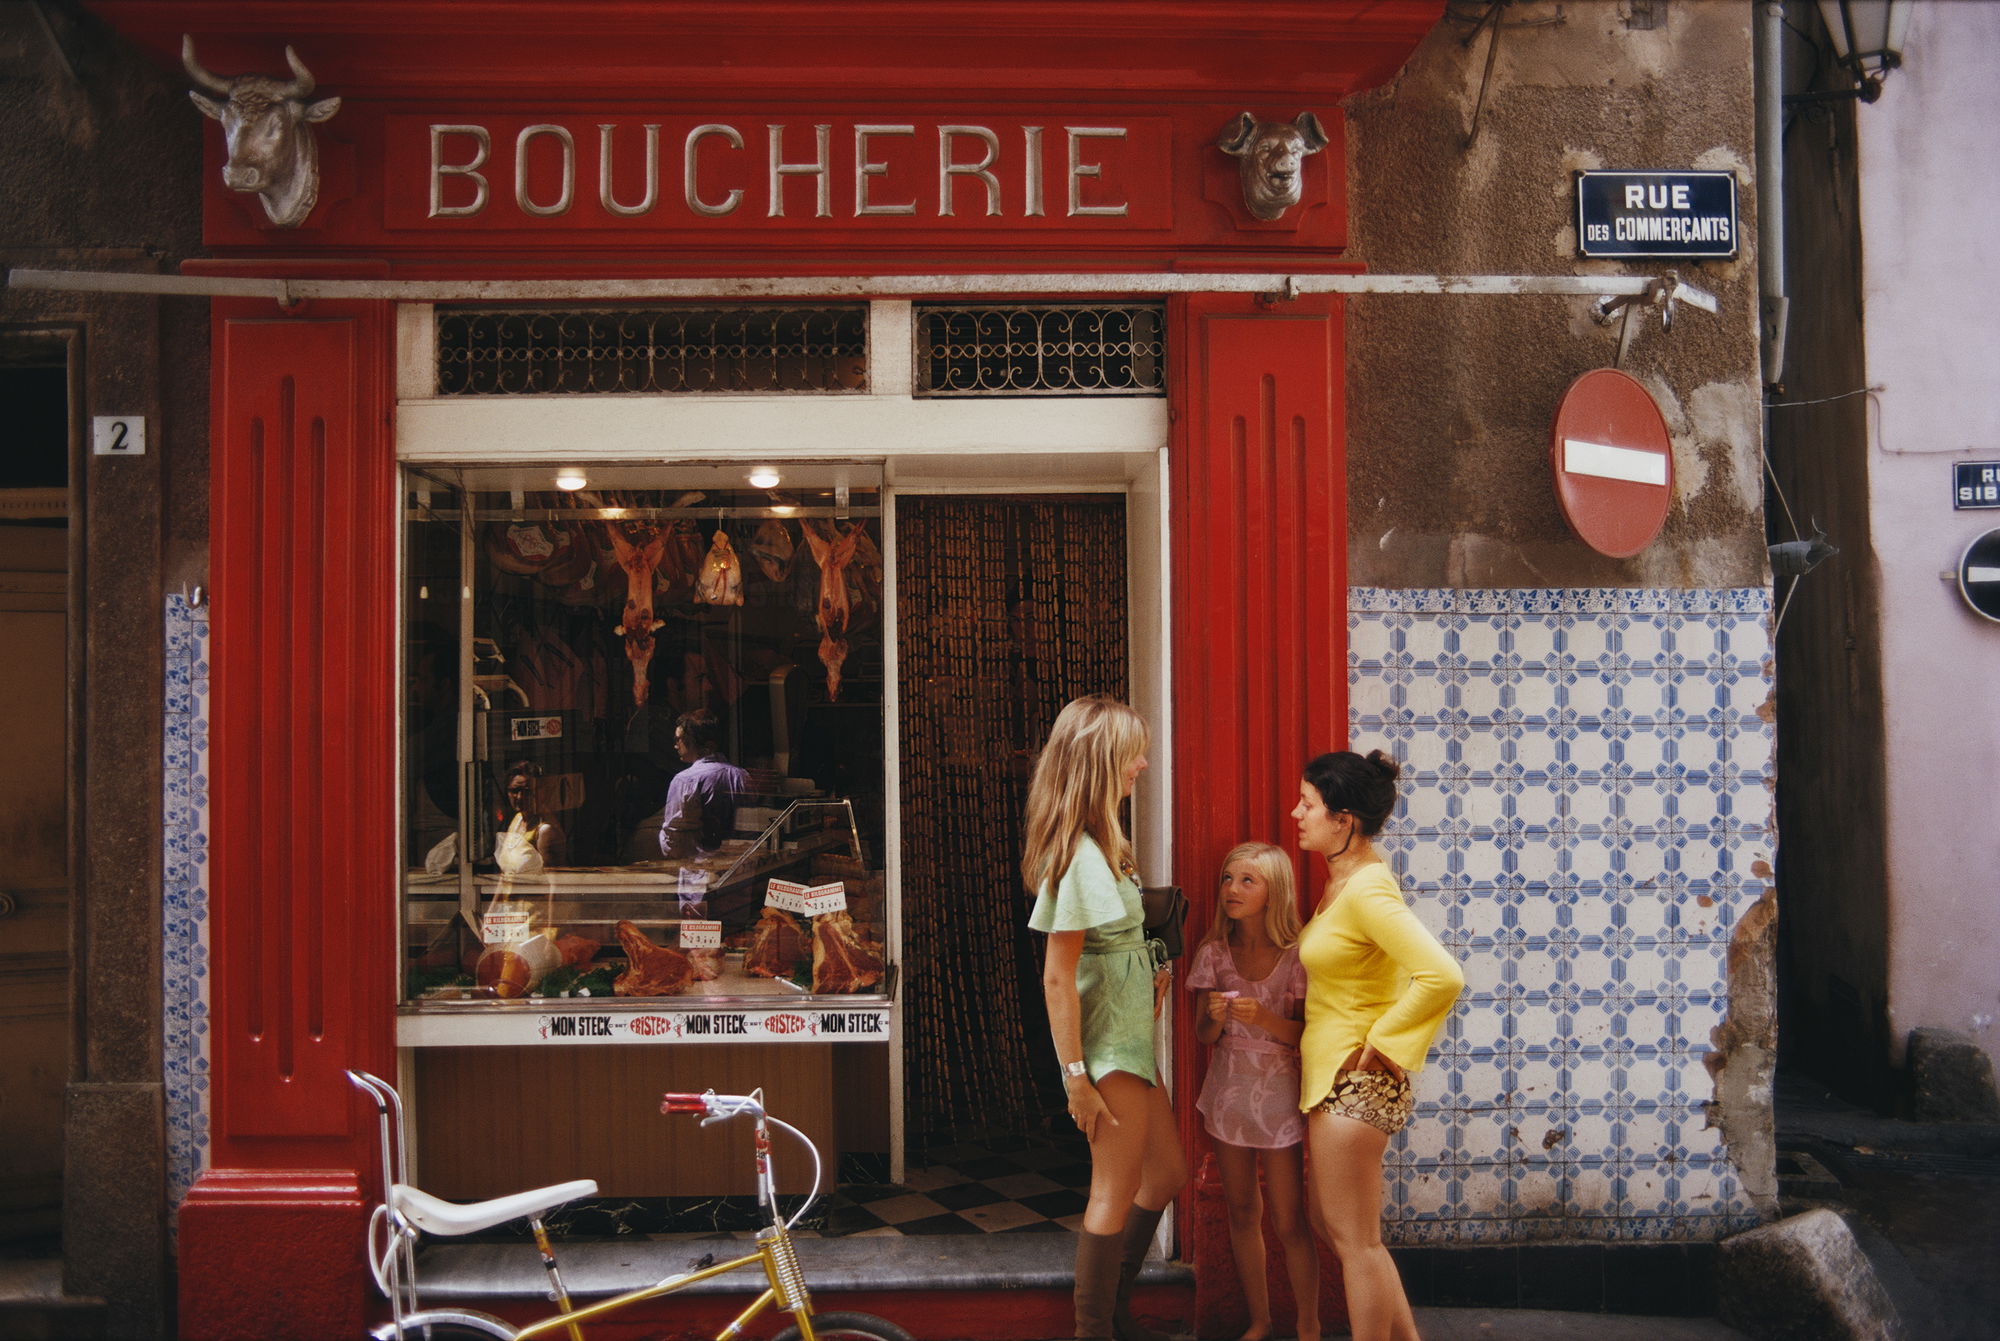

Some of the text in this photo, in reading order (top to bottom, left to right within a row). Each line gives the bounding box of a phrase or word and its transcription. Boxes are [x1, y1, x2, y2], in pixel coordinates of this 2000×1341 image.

[428, 124, 1129, 218] BOUCHERIE
[1624, 185, 1691, 209] RUE
[1587, 217, 1730, 243] DES COMMERÇANTS
[111, 421, 129, 450] 2
[551, 1016, 576, 1036] MON
[578, 1016, 613, 1036] STECK
[686, 1014, 711, 1034] MON
[713, 1014, 748, 1034] STECK
[821, 1013, 846, 1033] MON
[848, 1013, 883, 1033] STECK
